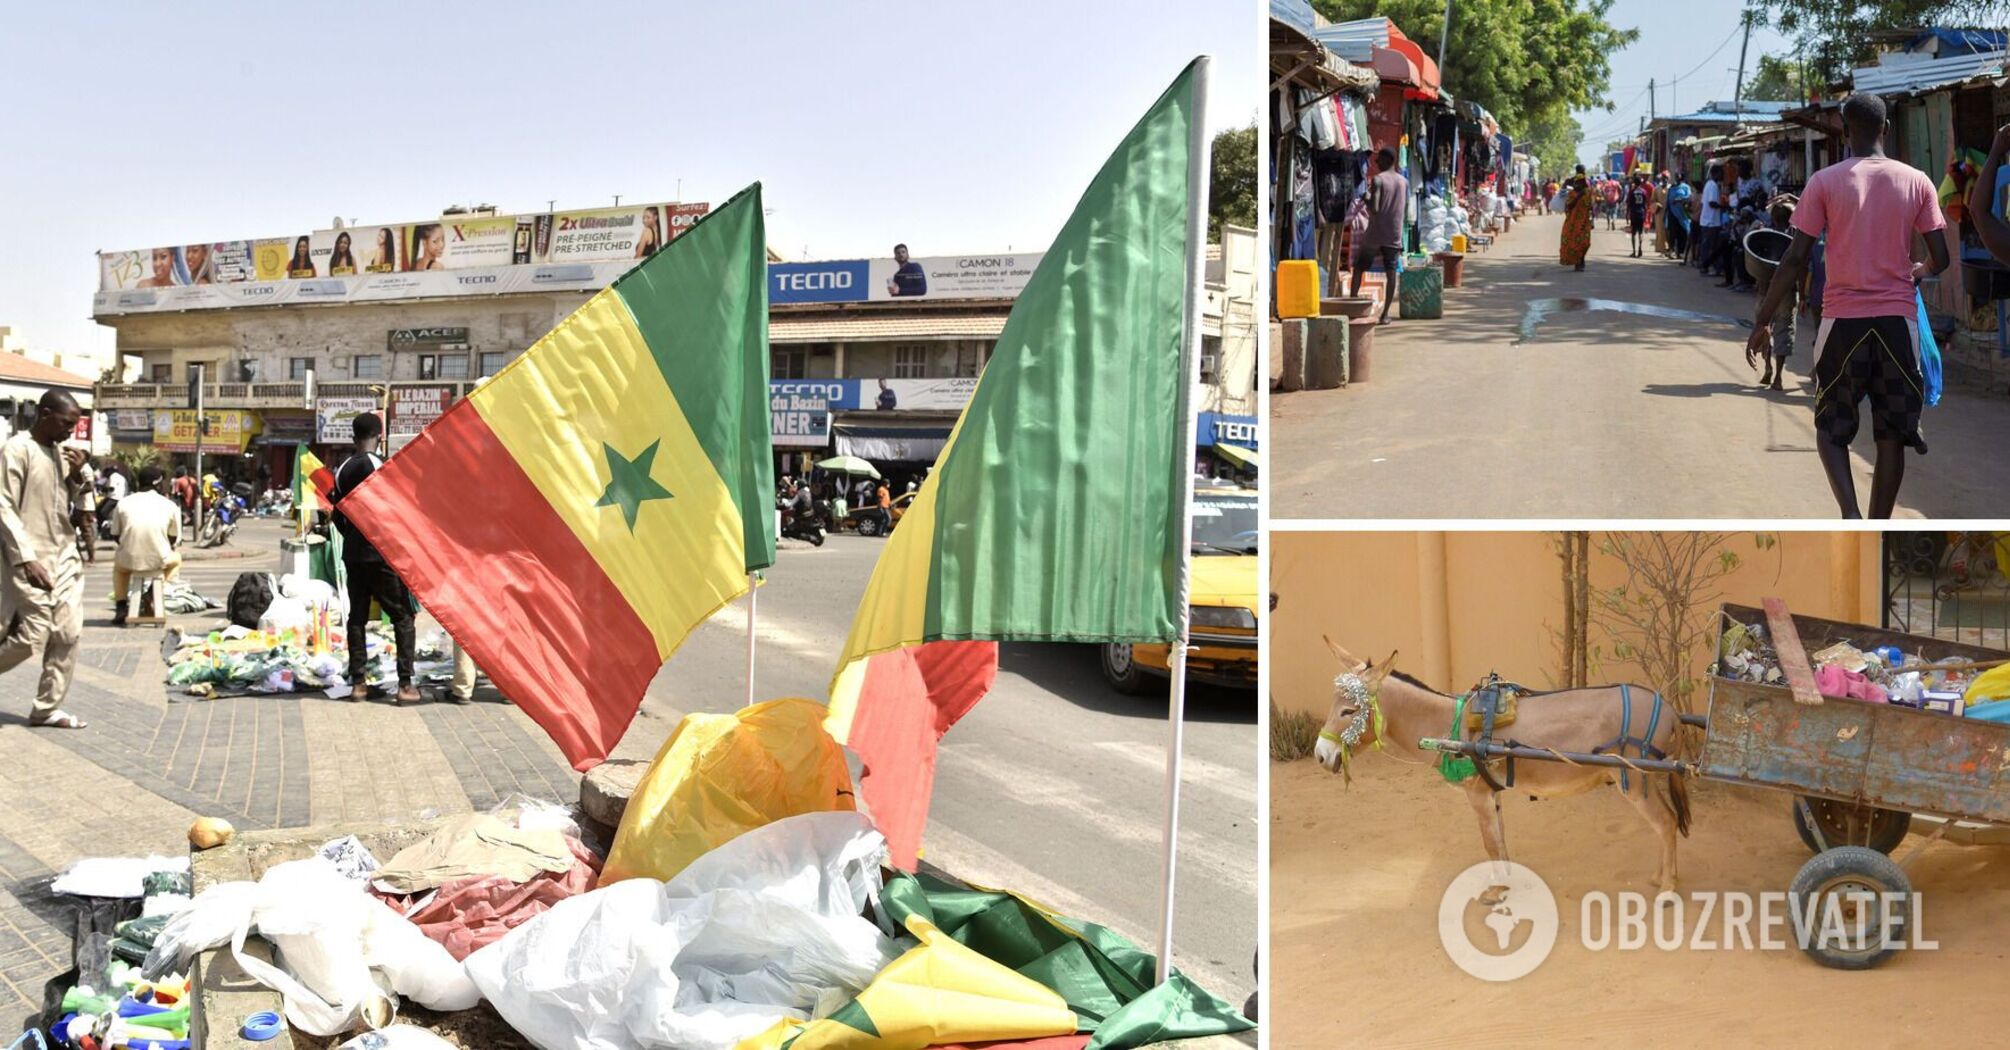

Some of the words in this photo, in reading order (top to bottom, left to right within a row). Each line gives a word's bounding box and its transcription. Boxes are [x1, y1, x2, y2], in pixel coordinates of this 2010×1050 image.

[559, 216, 578, 231] 2x
[554, 240, 633, 254] PRE-STRETCHED
[960, 258, 1001, 269] CAMON
[1005, 257, 1015, 267] 18
[456, 275, 497, 285] TECNO
[775, 270, 853, 291] TECNO
[242, 286, 274, 296] TECNO
[950, 379, 977, 387] CAMO
[769, 384, 843, 401] TECNO
[395, 401, 443, 415] IMPERIAL
[772, 396, 787, 411] du
[771, 412, 811, 434] NER
[174, 425, 220, 438] GETER
[1215, 421, 1258, 441] TECN
